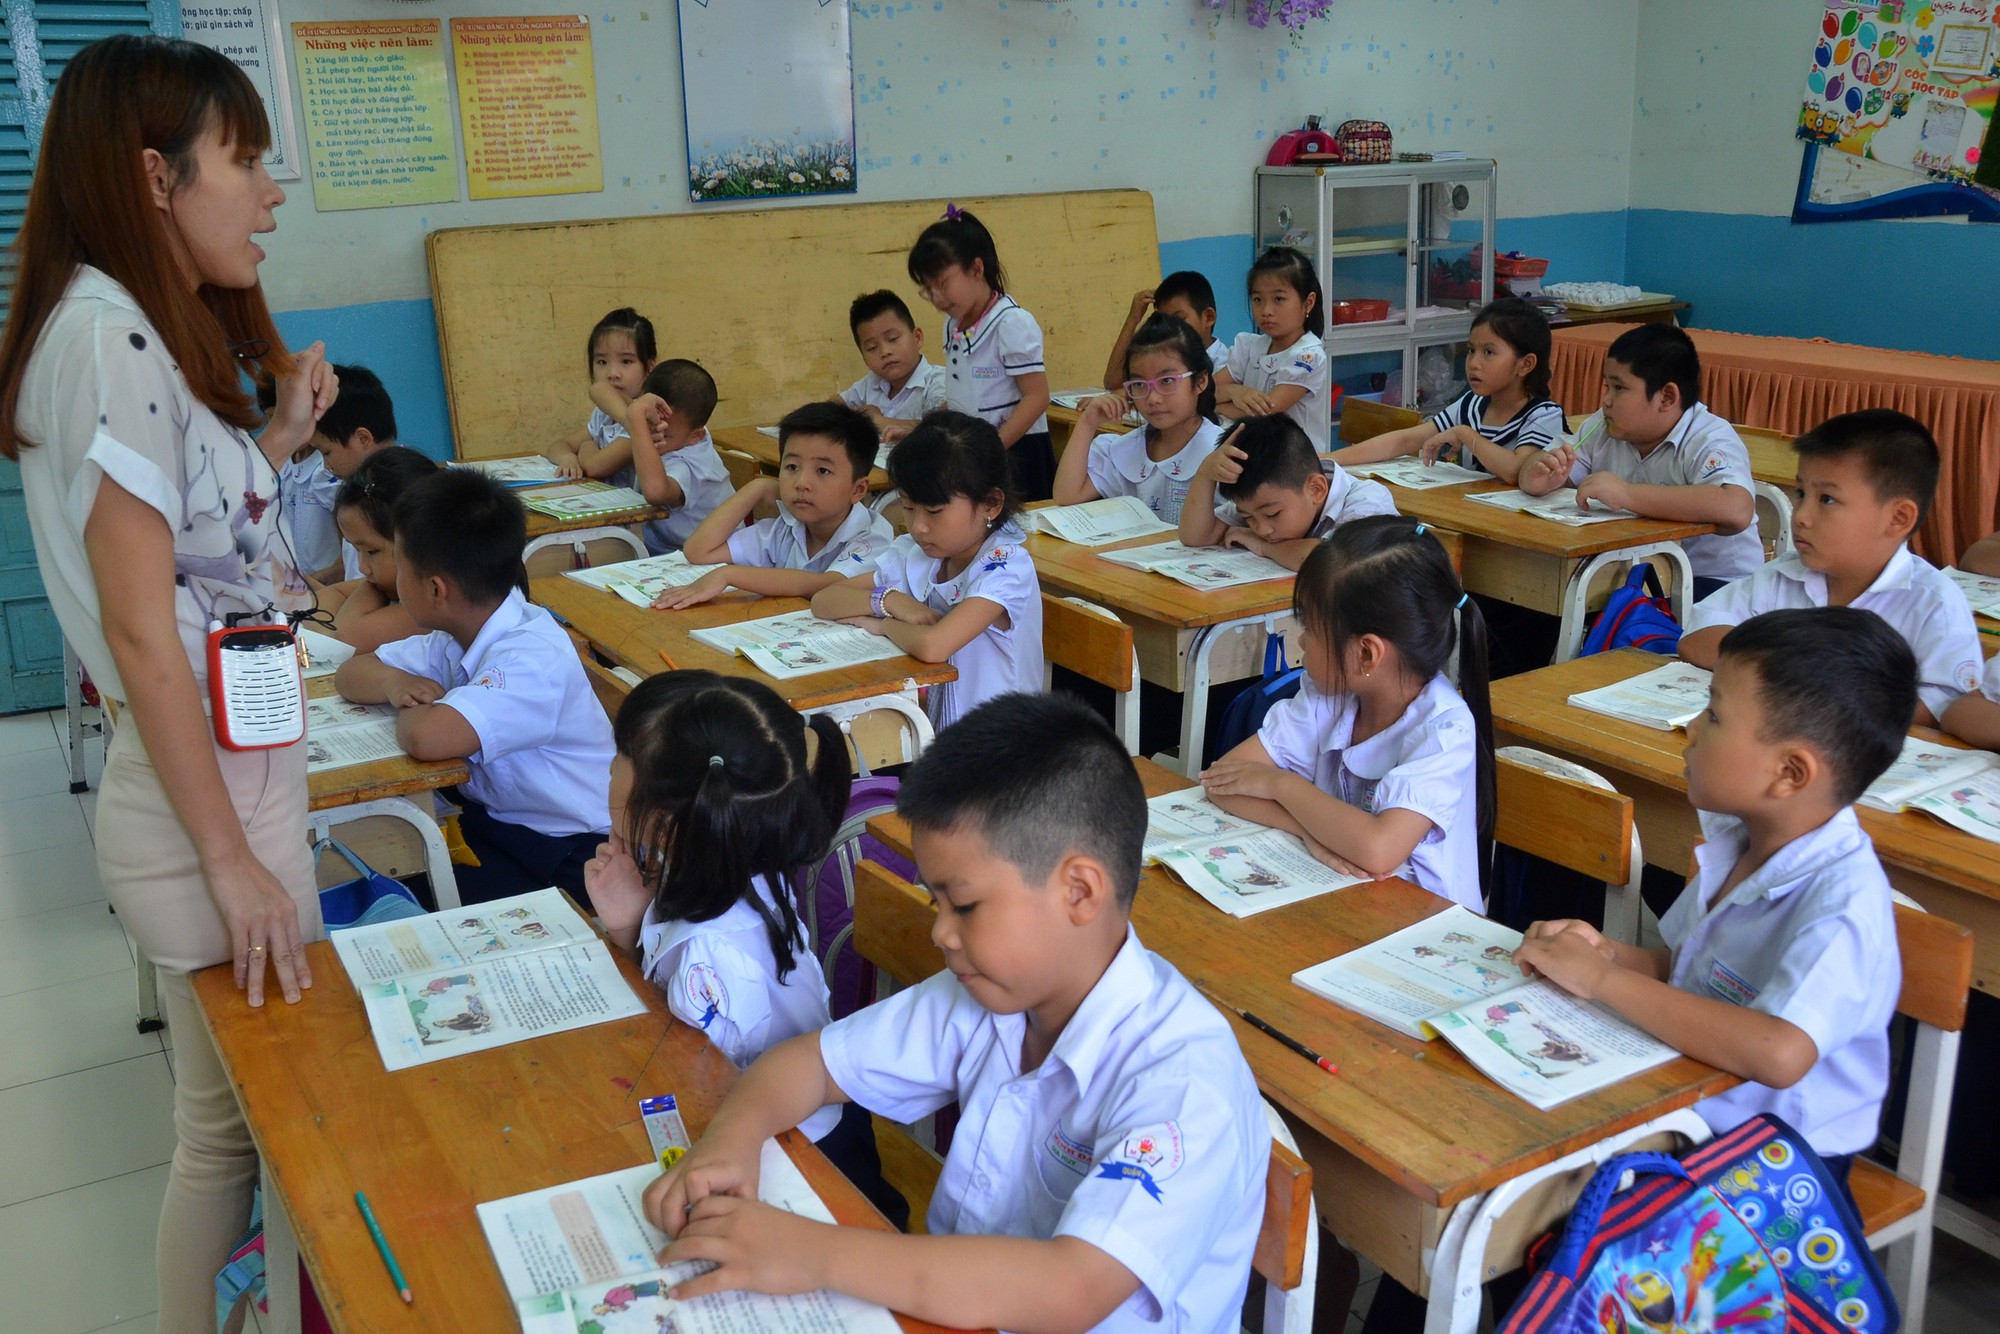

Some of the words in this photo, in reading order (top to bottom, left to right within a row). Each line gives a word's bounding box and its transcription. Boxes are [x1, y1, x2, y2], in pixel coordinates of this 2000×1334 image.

[182, 8, 197, 17] ộng
[199, 8, 214, 18] học
[216, 8, 231, 17] tập;
[233, 6, 252, 17] chấp
[1825, 10, 1829, 19] 1
[1857, 13, 1863, 22] 4
[195, 21, 208, 30] giữ
[210, 20, 222, 30] gìn
[224, 20, 243, 29] sách
[244, 19, 254, 28] vở
[460, 35, 490, 46] Những
[492, 35, 512, 45] việc
[514, 34, 542, 44] không
[545, 34, 562, 42] nên
[564, 33, 584, 42] làm:
[1819, 38, 1825, 47] 2
[1850, 38, 1856, 47] 5
[1896, 35, 1907, 45] 10
[305, 40, 346, 51] Những
[350, 39, 375, 50] việc
[379, 39, 402, 47] nên
[406, 38, 433, 46] làm:
[1871, 43, 1877, 53] 7
[223, 46, 243, 55] phép
[245, 46, 258, 54] với
[1812, 64, 1818, 73] 3
[1889, 62, 1898, 72] 11
[1840, 72, 1845, 81] 6
[1863, 74, 1869, 83] 8
[1904, 68, 1927, 81] GÓC
[307, 77, 315, 85] 3.
[1883, 89, 1892, 100] 12
[1911, 81, 1935, 95] HỌC
[1937, 87, 1960, 100] TẬP
[311, 108, 319, 116] 6.
[1855, 110, 1861, 119] 9
[315, 139, 323, 147] 8.
[318, 159, 326, 167] 9.
